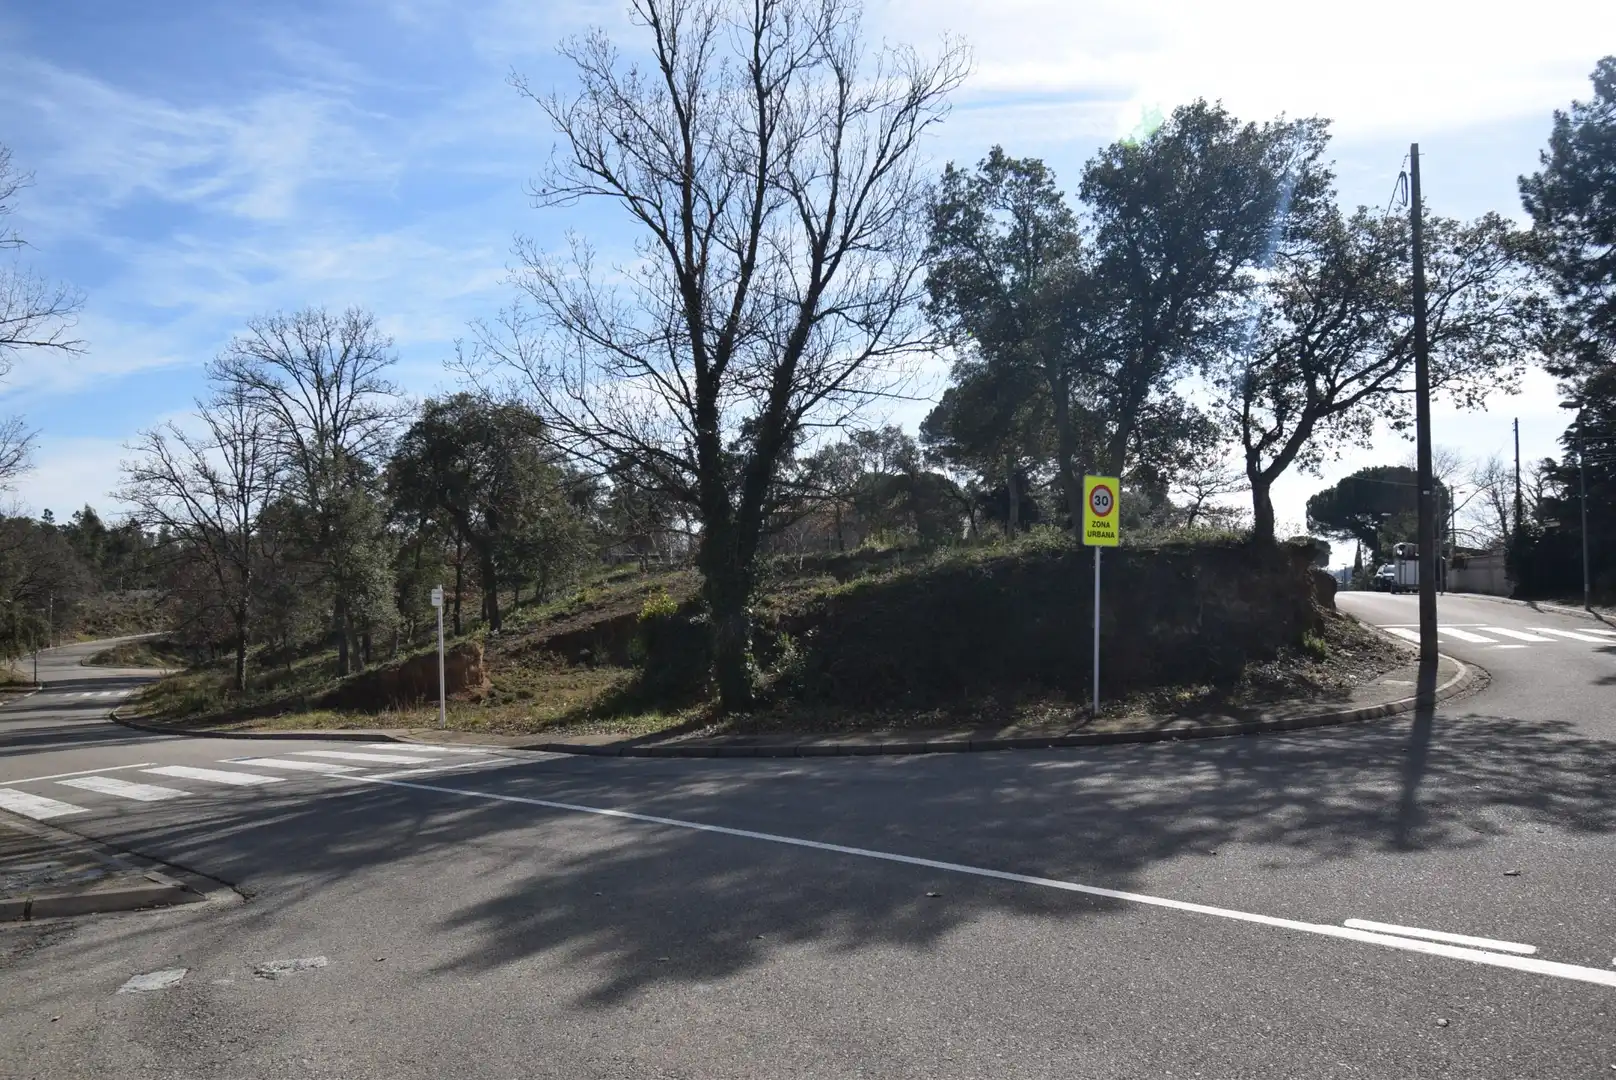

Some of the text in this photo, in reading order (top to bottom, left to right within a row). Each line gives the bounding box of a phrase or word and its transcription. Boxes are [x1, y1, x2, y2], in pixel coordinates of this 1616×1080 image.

[1094, 495, 1109, 506] 30
[1092, 520, 1111, 528] ZONA
[1087, 530, 1115, 538] URBANA
